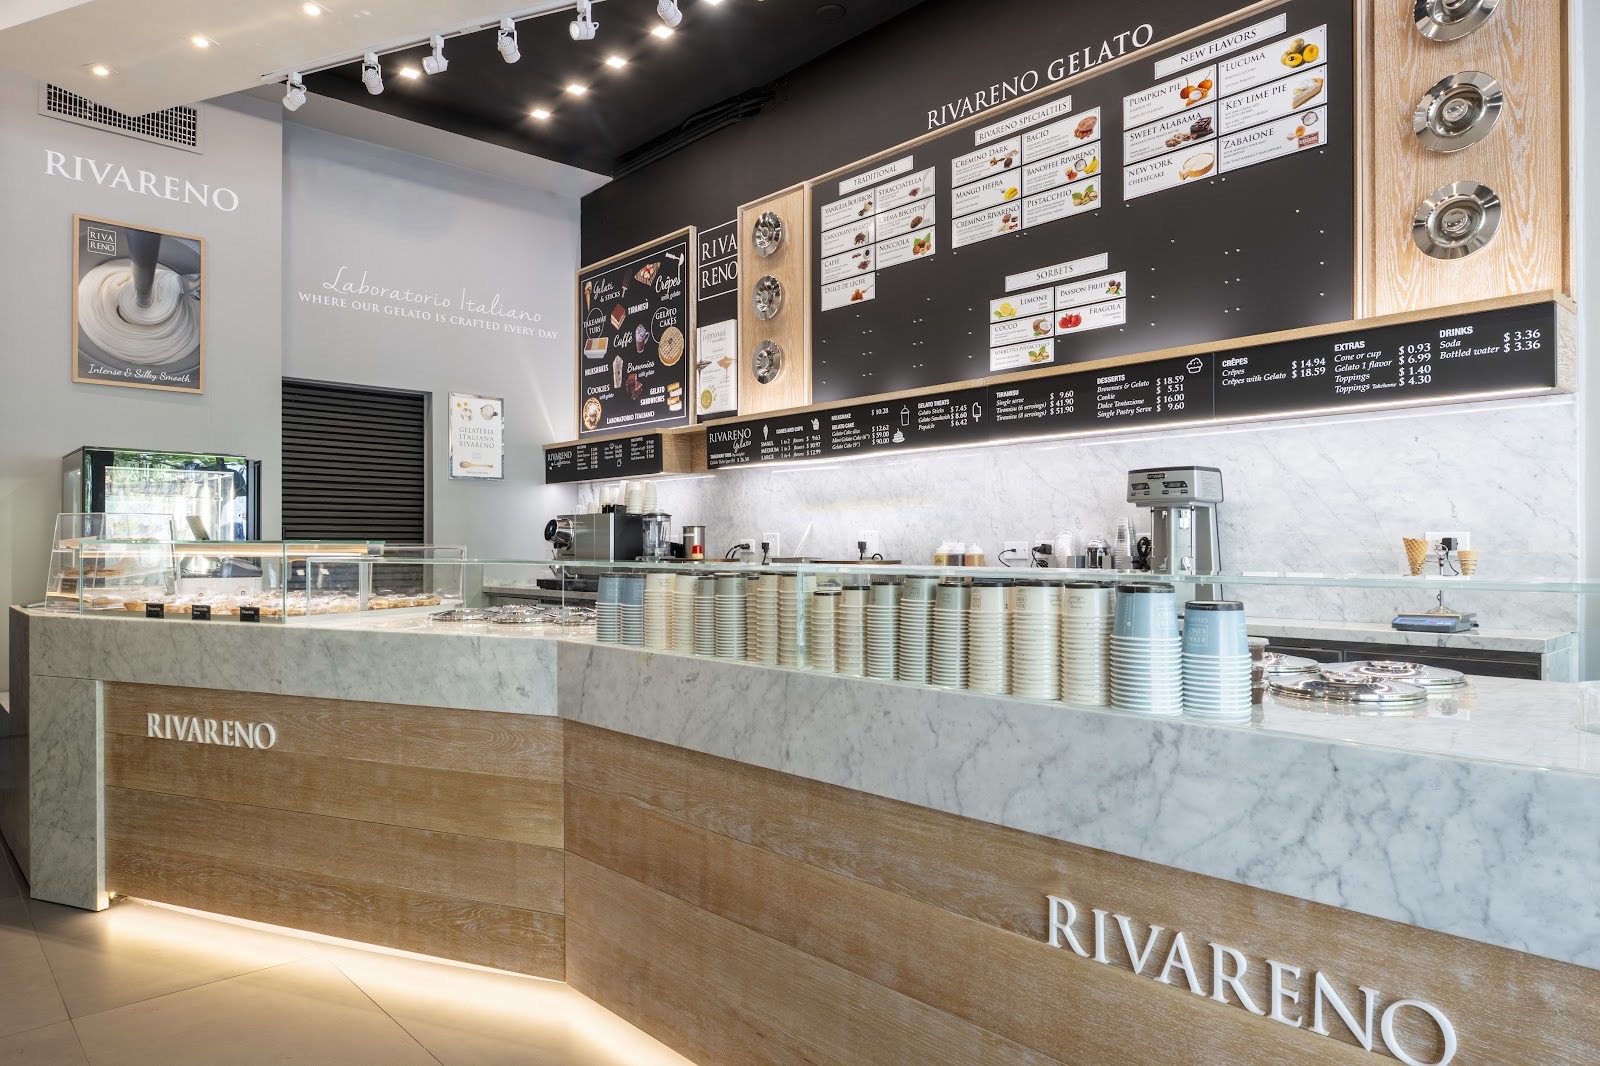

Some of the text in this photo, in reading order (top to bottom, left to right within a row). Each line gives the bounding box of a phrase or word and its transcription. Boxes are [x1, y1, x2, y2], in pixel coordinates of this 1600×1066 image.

[1180, 29, 1257, 65] NEW FLAVORS
[1225, 52, 1266, 72] LUCUMA
[927, 23, 1153, 130] RIVARENO GELATO
[1129, 84, 1181, 106] PUMPKIN PIE
[1226, 84, 1287, 110] KEY LIME PIE
[979, 101, 1067, 140] RIVARENO SPECIALTIES
[1130, 127, 1157, 141] SWEET
[1159, 112, 1201, 131] ALABAMA
[1026, 130, 1049, 143] BACIO
[1223, 128, 1274, 150] ZABAIONE
[956, 146, 1008, 169] CREMINO DARK
[1026, 149, 1095, 176] BANOFFEE RIVARENO
[854, 165, 897, 186] TRADITIONAL
[1129, 158, 1173, 178] NEW YORK
[44, 150, 238, 211] RIVARENO
[879, 177, 922, 196] STRACCIATELLA
[1128, 172, 1164, 186] CHEESECAKE
[956, 187, 981, 200] MANGO
[1026, 189, 1072, 208] PISTACCHIO
[825, 203, 847, 213] VANIGLIA
[848, 193, 872, 206] BOURBON
[899, 204, 927, 217] BISCOTTO
[956, 216, 986, 229] CREMINO
[987, 204, 1020, 220] RIVARENO
[91, 231, 114, 242] RIVA
[91, 241, 114, 251] RENO
[701, 233, 737, 261] RIVA
[880, 239, 910, 251] NOCCIOLA
[701, 261, 738, 289] RENO
[1037, 265, 1074, 280] SORBETS
[593, 279, 614, 300] Gelati
[655, 276, 681, 296] Crêpes
[825, 283, 841, 294] DULCE
[850, 278, 866, 287] LECHE
[1060, 282, 1108, 296] PASSION FRUIT
[323, 266, 541, 322] Laboratorio Italiano
[605, 291, 620, 301] STICKS
[1020, 294, 1048, 305] LIMONE
[298, 292, 558, 339] WHERE OUR GELATO IS CRAFTED EVERY DAY
[655, 308, 677, 320] GELATO
[1090, 304, 1121, 314] FRAGOLA
[583, 315, 607, 329] TAKEAWAY
[660, 317, 677, 328] CAKES
[995, 323, 1018, 331] COCCO
[589, 326, 600, 335] TUBS
[1440, 326, 1473, 338] DRINKS
[1335, 341, 1365, 351] EXTRAS
[1440, 329, 1540, 349] Soda 3.36
[1334, 354, 1354, 362] Cone
[1367, 351, 1381, 359] cup
[1408, 343, 1430, 354] 0.93
[1440, 340, 1540, 359] Bottled water 3.36
[585, 364, 609, 376] MILKSHAKES
[627, 360, 655, 373] Brownies
[1222, 358, 1248, 367] CRÊPES
[1222, 358, 1325, 378] Crêpes 14.94
[1335, 364, 1360, 372] Gelato
[1367, 360, 1392, 370] flavor
[1408, 353, 1431, 363] 6.99
[88, 364, 191, 382] Intense & Silky Smooth
[1097, 374, 1125, 384] DESSERTS
[1222, 367, 1326, 386] Crêpes with Gelato 18.59
[1335, 365, 1431, 383] Toppings 1.40
[587, 384, 610, 395] COOKIES
[650, 386, 665, 395] GELATO
[1097, 384, 1122, 392] Brownies
[1164, 375, 1184, 385] 18.59
[1335, 384, 1370, 394] Toppings
[1408, 375, 1431, 385] 4.30
[996, 390, 1019, 398] TIRAMISU
[1059, 390, 1074, 398] 9.60
[1097, 384, 1184, 401] Cookie 5.51
[640, 395, 665, 406] SANDWICHES
[1056, 398, 1074, 406] 41.90
[1114, 399, 1144, 407] Tentazione
[1164, 394, 1184, 403] 16.00
[1168, 402, 1184, 410] 9.60
[832, 413, 851, 421] MILKSHAKE
[1056, 406, 1074, 414] 51.90
[607, 411, 655, 425] LABORATORIO ITALIANO
[459, 427, 494, 435] GELATERIA
[709, 428, 751, 443] RIVARENO
[733, 439, 751, 453] Gelato
[548, 450, 572, 461] RIVARENO
[146, 713, 276, 749] RIVARENO
[1045, 894, 1457, 1066] RIVARENO
